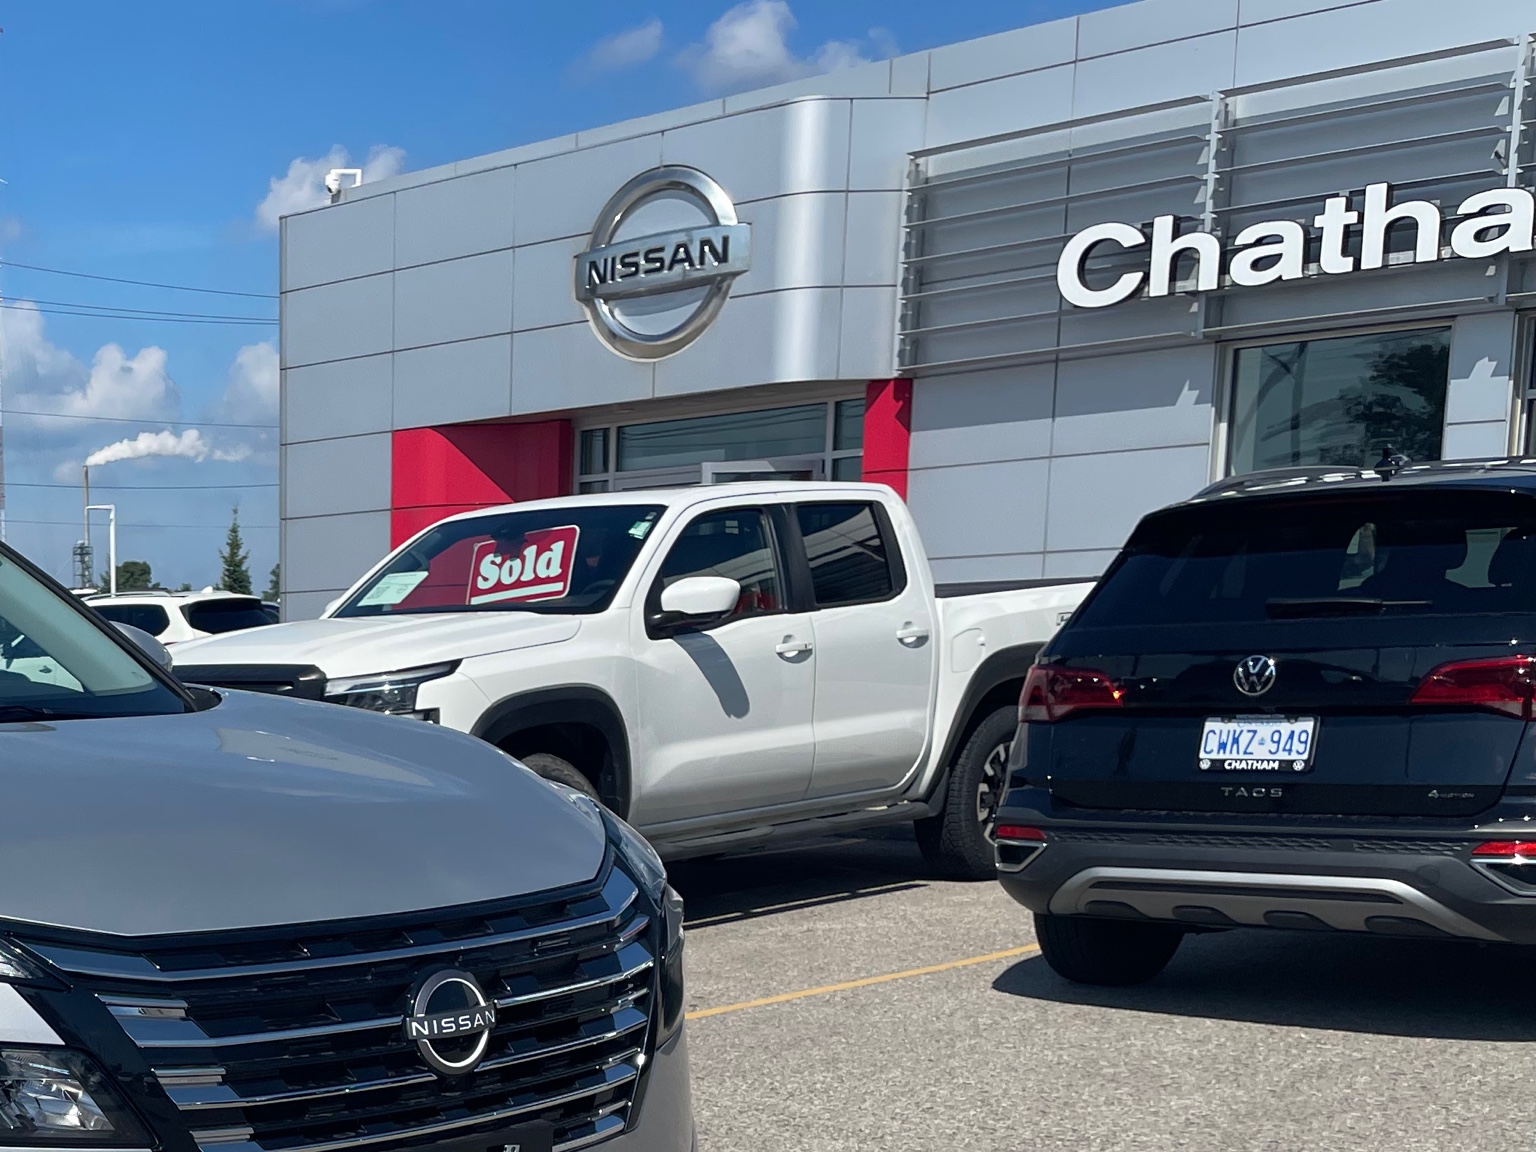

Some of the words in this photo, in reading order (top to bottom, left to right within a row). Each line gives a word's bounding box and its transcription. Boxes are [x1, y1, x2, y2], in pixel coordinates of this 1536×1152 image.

[587, 234, 730, 288] NISSAN
[1056, 182, 1535, 308] Chatha
[477, 541, 565, 590] Sold
[1224, 760, 1279, 770] CHATHAM
[410, 1009, 496, 1037] NISSAN
